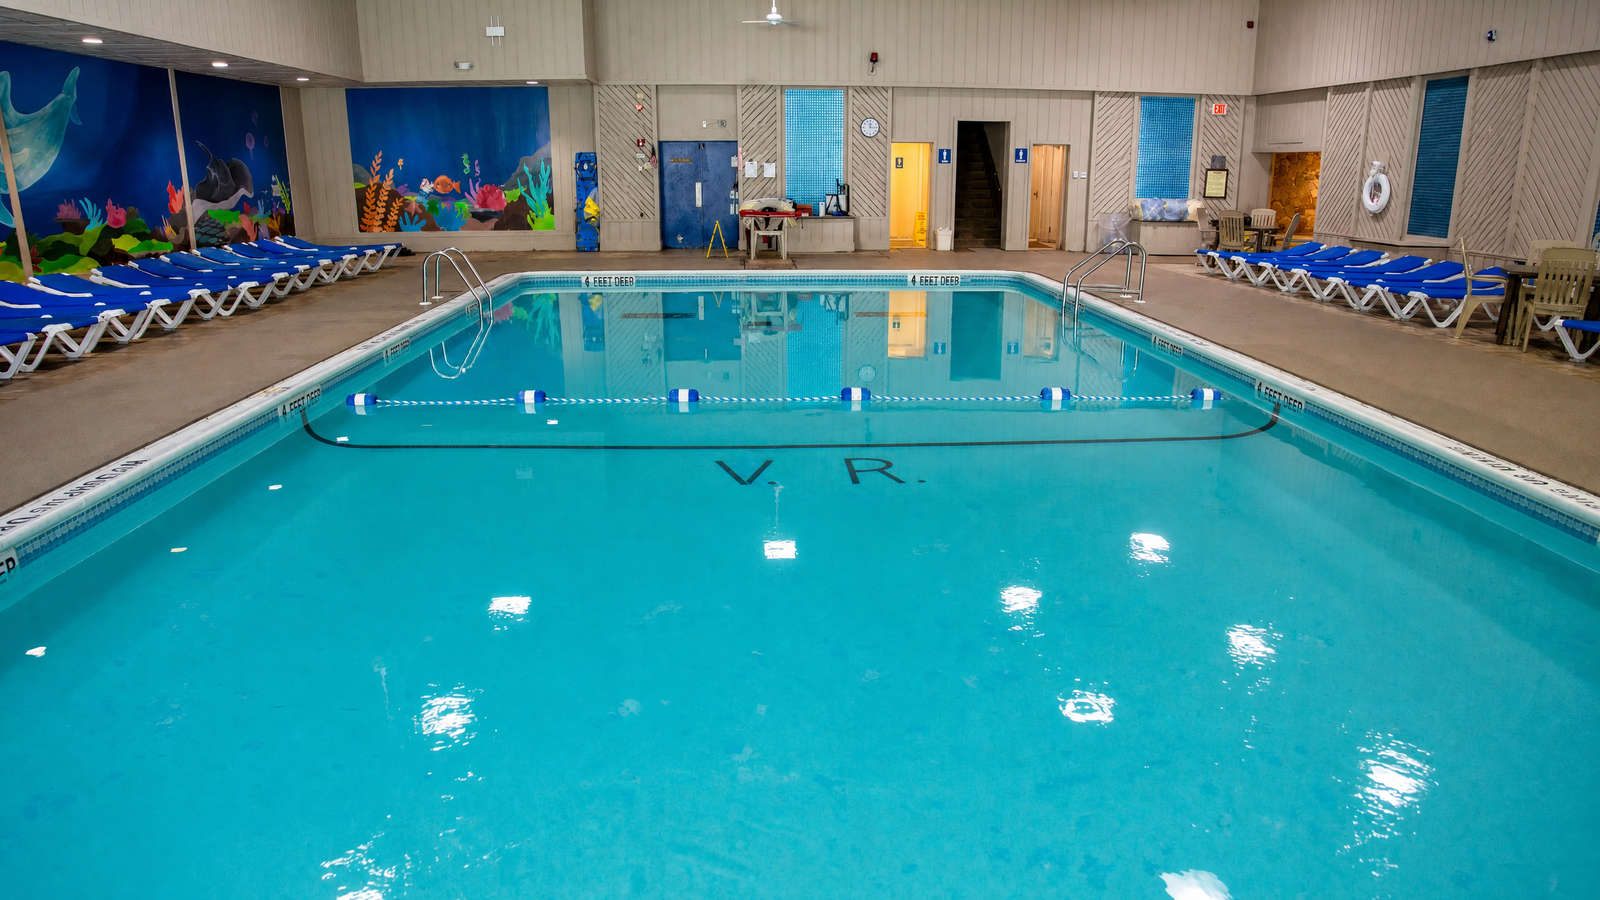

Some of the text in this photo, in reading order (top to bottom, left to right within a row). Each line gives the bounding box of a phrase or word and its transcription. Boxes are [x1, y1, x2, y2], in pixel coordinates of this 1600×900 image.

[585, 276, 590, 287] 4
[911, 275, 916, 286] 4
[1264, 386, 1282, 405] FEET
[1283, 395, 1303, 413] DEEP
